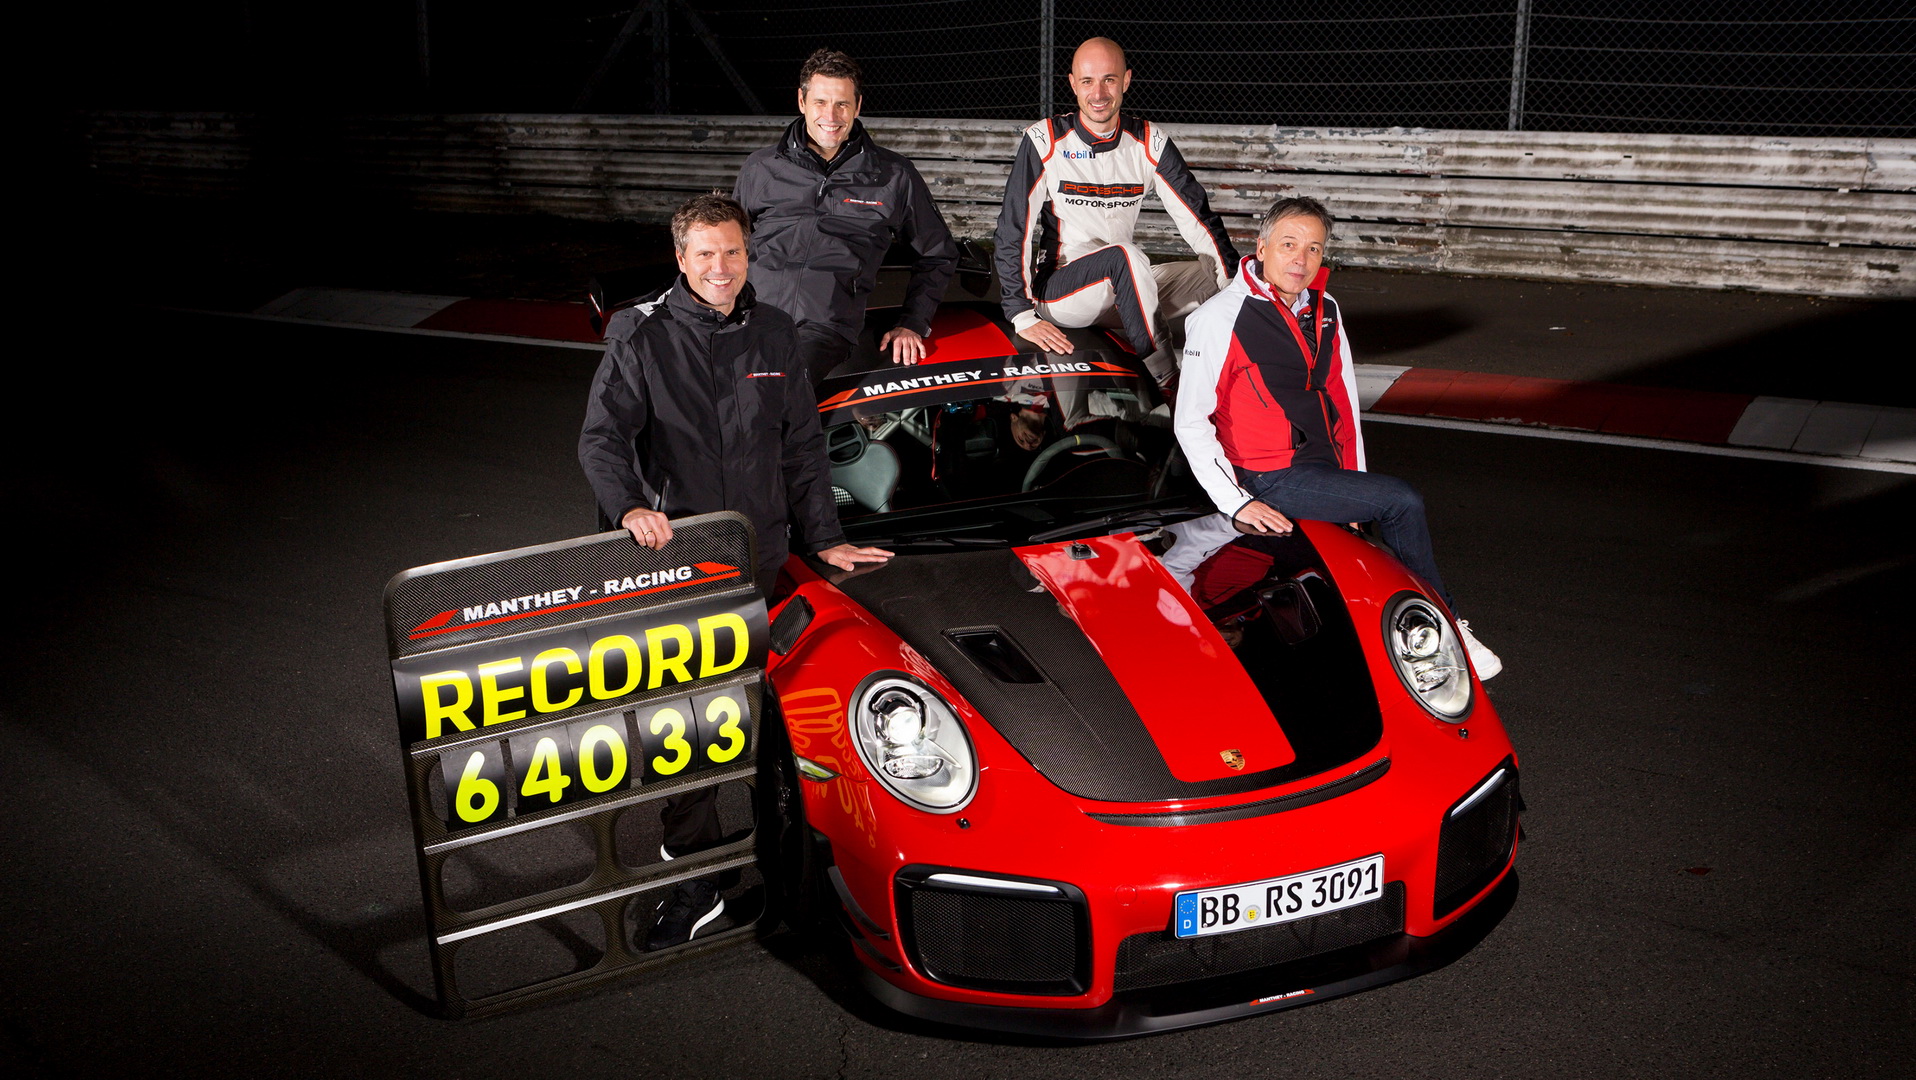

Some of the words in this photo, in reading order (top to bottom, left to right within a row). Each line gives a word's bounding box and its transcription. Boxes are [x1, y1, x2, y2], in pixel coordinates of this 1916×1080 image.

[1063, 151, 1087, 159] Mobil
[1063, 183, 1143, 195] PORSCHE
[1065, 198, 1141, 209] MOTORSPORT
[863, 369, 982, 397] MANTHEY
[1003, 362, 1092, 377] RACING
[463, 585, 583, 622] MANTHEY
[604, 565, 693, 595] RACING
[420, 612, 750, 740] RECORD
[455, 751, 499, 823] 6
[520, 724, 628, 803] 40
[650, 696, 746, 776] 33
[1201, 893, 1240, 929] BB
[1266, 881, 1303, 919] RS
[1311, 863, 1379, 908] 3091
[1183, 919, 1192, 930] D
